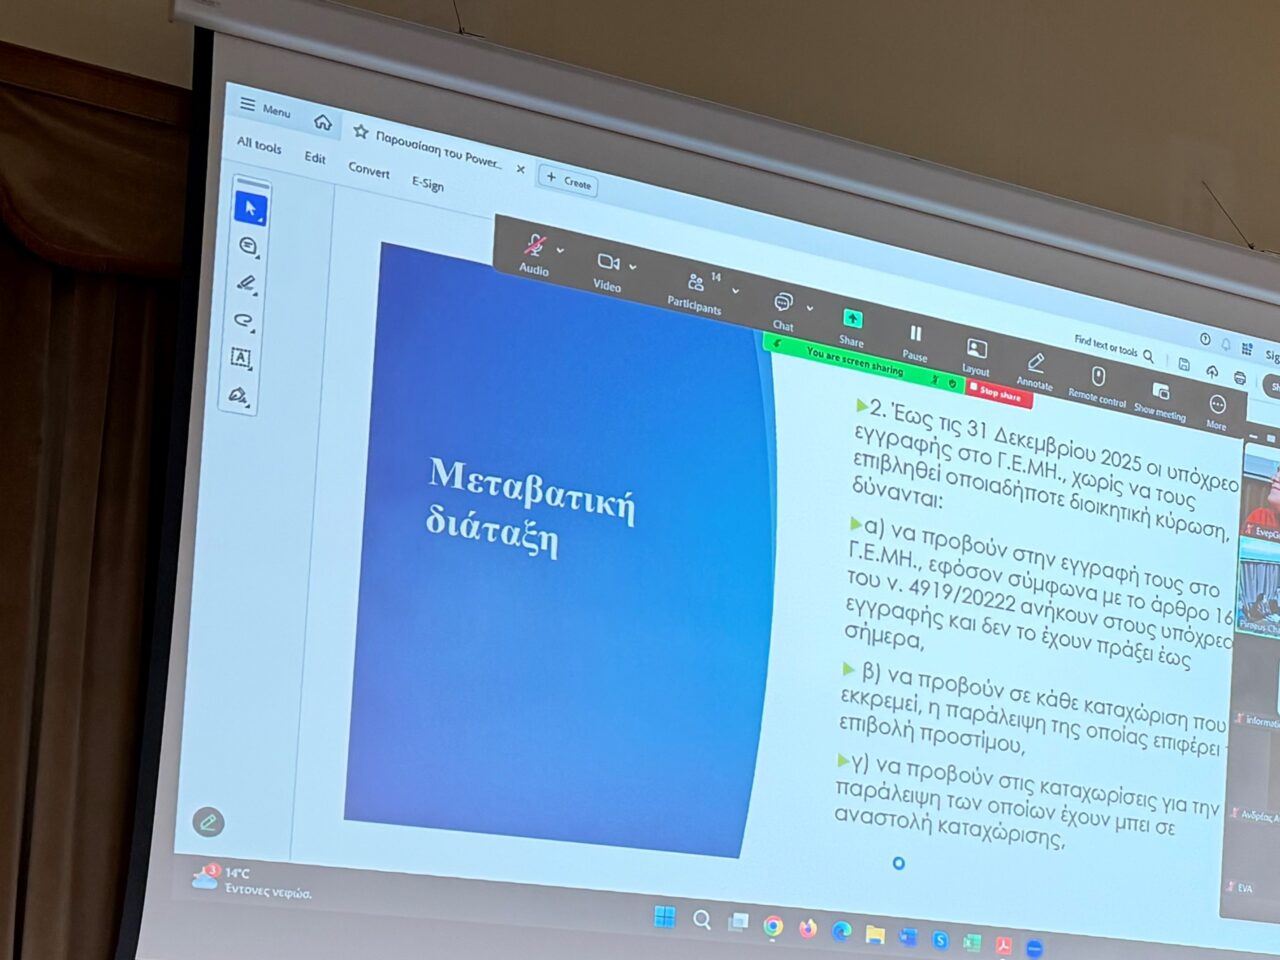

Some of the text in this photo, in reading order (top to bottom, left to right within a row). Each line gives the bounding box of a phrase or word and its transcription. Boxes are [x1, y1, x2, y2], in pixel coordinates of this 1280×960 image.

[263, 104, 290, 118] Menu
[237, 136, 282, 155] All tools
[376, 130, 441, 157] Παρουσίαση
[444, 148, 463, 160] του
[305, 151, 326, 165] Edit
[349, 162, 390, 179] Convert
[412, 175, 445, 193] E-Sign
[564, 176, 592, 190] Create
[519, 262, 550, 277] Audio
[711, 271, 721, 282] 14
[593, 278, 621, 293] Video
[667, 295, 721, 316] Participants
[773, 319, 794, 333] Chat
[839, 334, 864, 349] Share
[1075, 334, 1138, 357] Find text or tools
[807, 346, 904, 378] You are screen sharing
[903, 349, 928, 363] Pause
[962, 363, 990, 378] Layout
[980, 386, 1021, 402] Stop share
[1017, 376, 1053, 392] Annotate
[1069, 388, 1126, 409] Remote control
[1134, 403, 1186, 424] Show meeting
[1206, 419, 1227, 432] More
[870, 399, 887, 419] 2.
[891, 401, 933, 431] Έως
[939, 414, 962, 437] τις
[967, 419, 988, 439] 31
[994, 426, 1096, 463] Δεκεμβρίου
[1101, 448, 1142, 472] 2025
[1146, 462, 1163, 478] οι
[855, 425, 1197, 512] εγγραφής στο Γ.Ε.ΜΗ., χωρίς να τους
[428, 456, 635, 528] Μεταβατική
[852, 477, 944, 511] δύνανται:
[853, 452, 1231, 543] επιβληθεί οποιαδήποτε διοικητική κύρωση,
[425, 504, 559, 561] διάταξη
[864, 517, 1221, 600] α) να προβούν στην εγγραφή τους στο
[848, 540, 1233, 626] Γ.Ε.ΜΗ., εφόσον σύμφωνα με το άρθρο 16
[847, 569, 882, 588] του
[887, 576, 904, 593] ν.
[908, 579, 1016, 614] 4919/20222
[1020, 599, 1098, 626] ανήκουν
[1103, 617, 1157, 640] στους
[844, 625, 925, 652] σήμερα,
[845, 597, 1192, 672] εγγραφής και δεν το έχουν πράξει έως
[862, 660, 1227, 734] β) να προβούν σε κάθε καταχώριση που
[841, 688, 1221, 758] εκκρεμεί, η παράλειψη της οποίας επιφέρει
[839, 715, 1026, 757] επιβολή προστίμου,
[851, 752, 1220, 818] γ) να προβούν στις καταχωρίσεις για την
[836, 778, 1175, 837] παράλειψη των οποίων έχουν μπει σε
[834, 804, 1065, 851] αναστολή καταχώρισης,
[225, 867, 250, 879] 14°C
[225, 882, 270, 898] Έντονες
[1238, 884, 1253, 893] EVA
